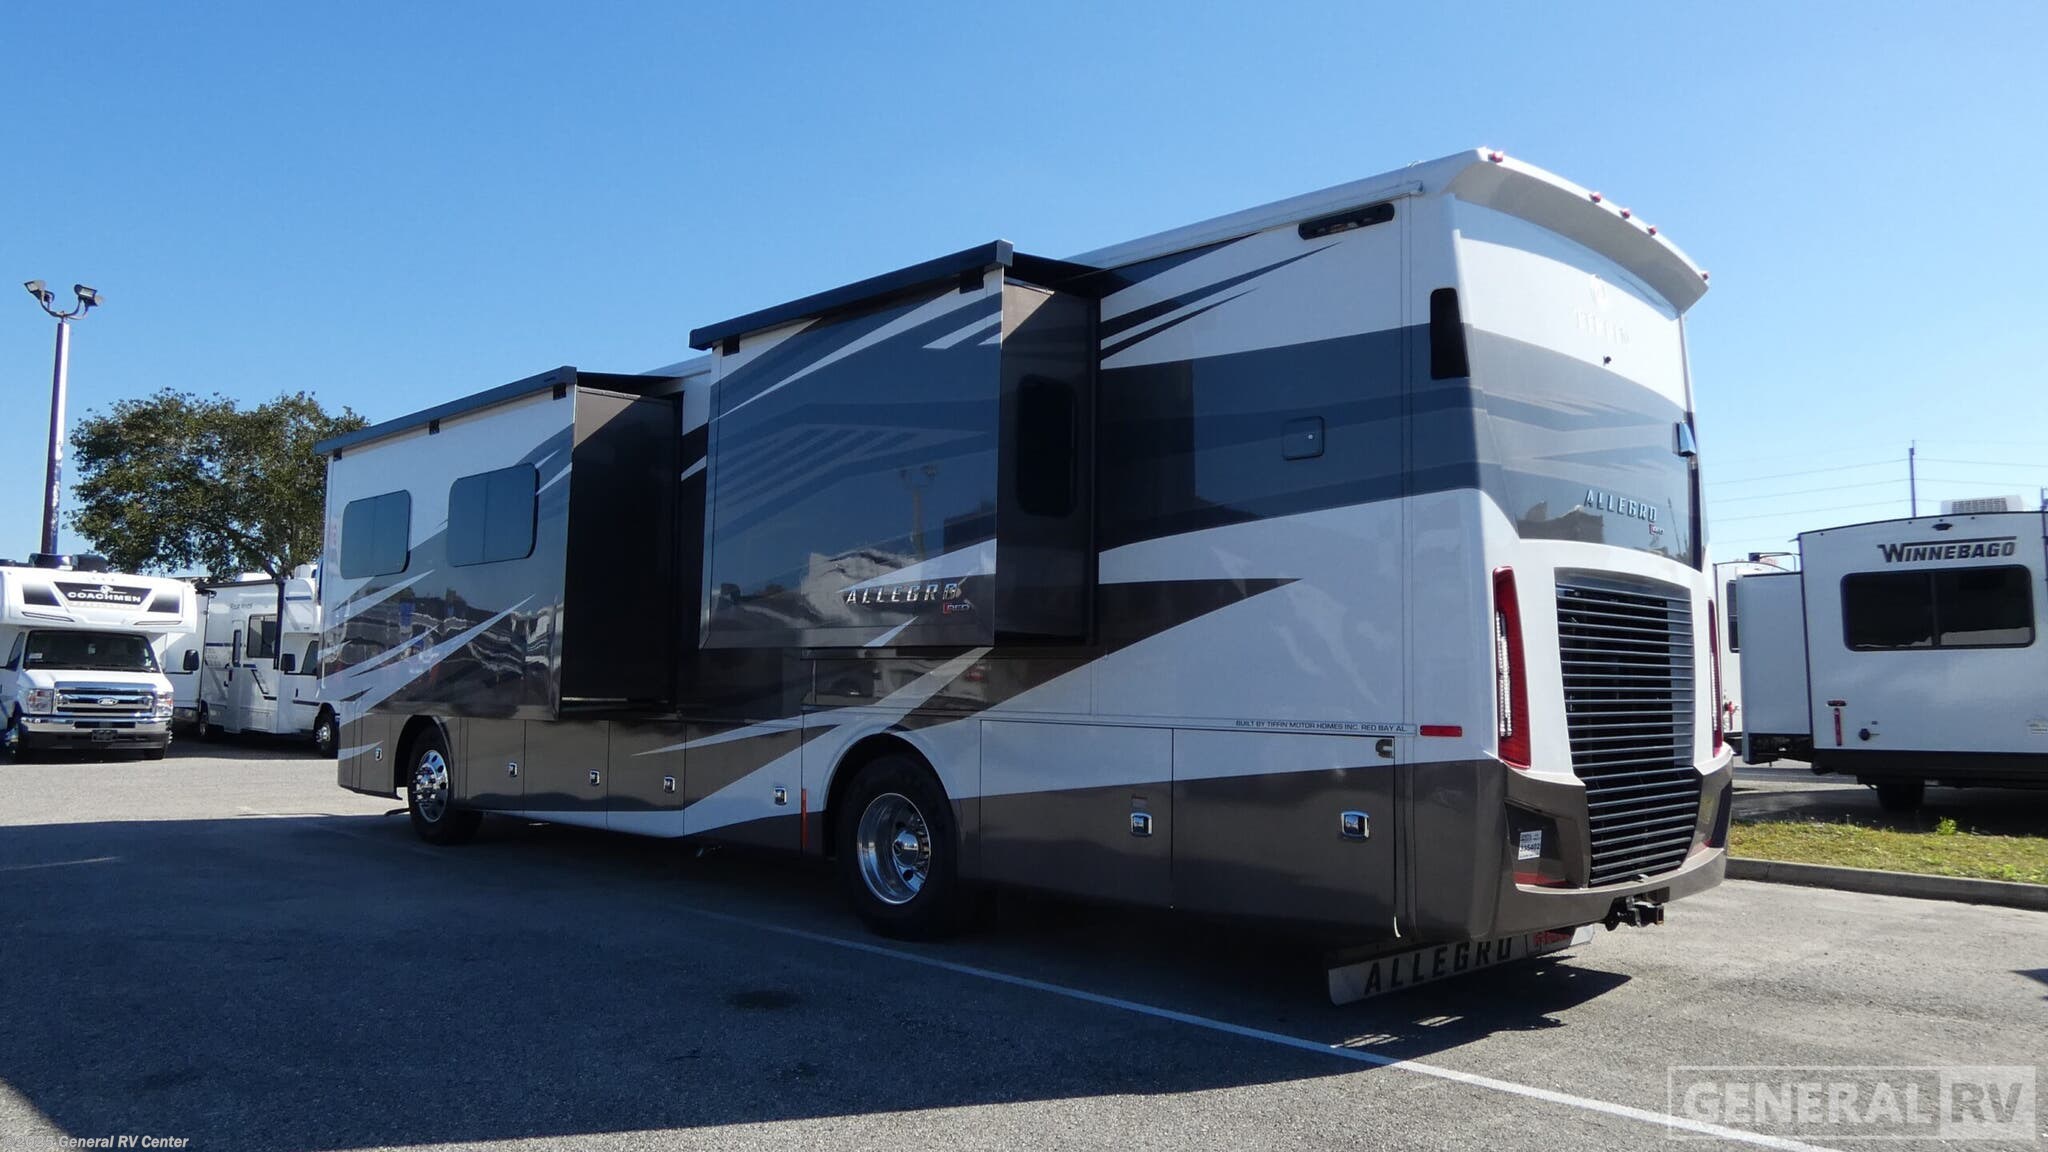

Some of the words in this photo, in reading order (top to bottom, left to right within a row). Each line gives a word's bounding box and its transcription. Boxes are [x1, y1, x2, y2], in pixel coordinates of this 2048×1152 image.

[1583, 488, 1658, 523] ALLEGRO
[1877, 536, 2017, 563] WINNEBAGO
[67, 591, 141, 603] COACHMEN
[846, 583, 960, 604] ALLEGRO
[1316, 722, 1343, 730] HOMES
[1364, 937, 1513, 995] ALLEGRO
